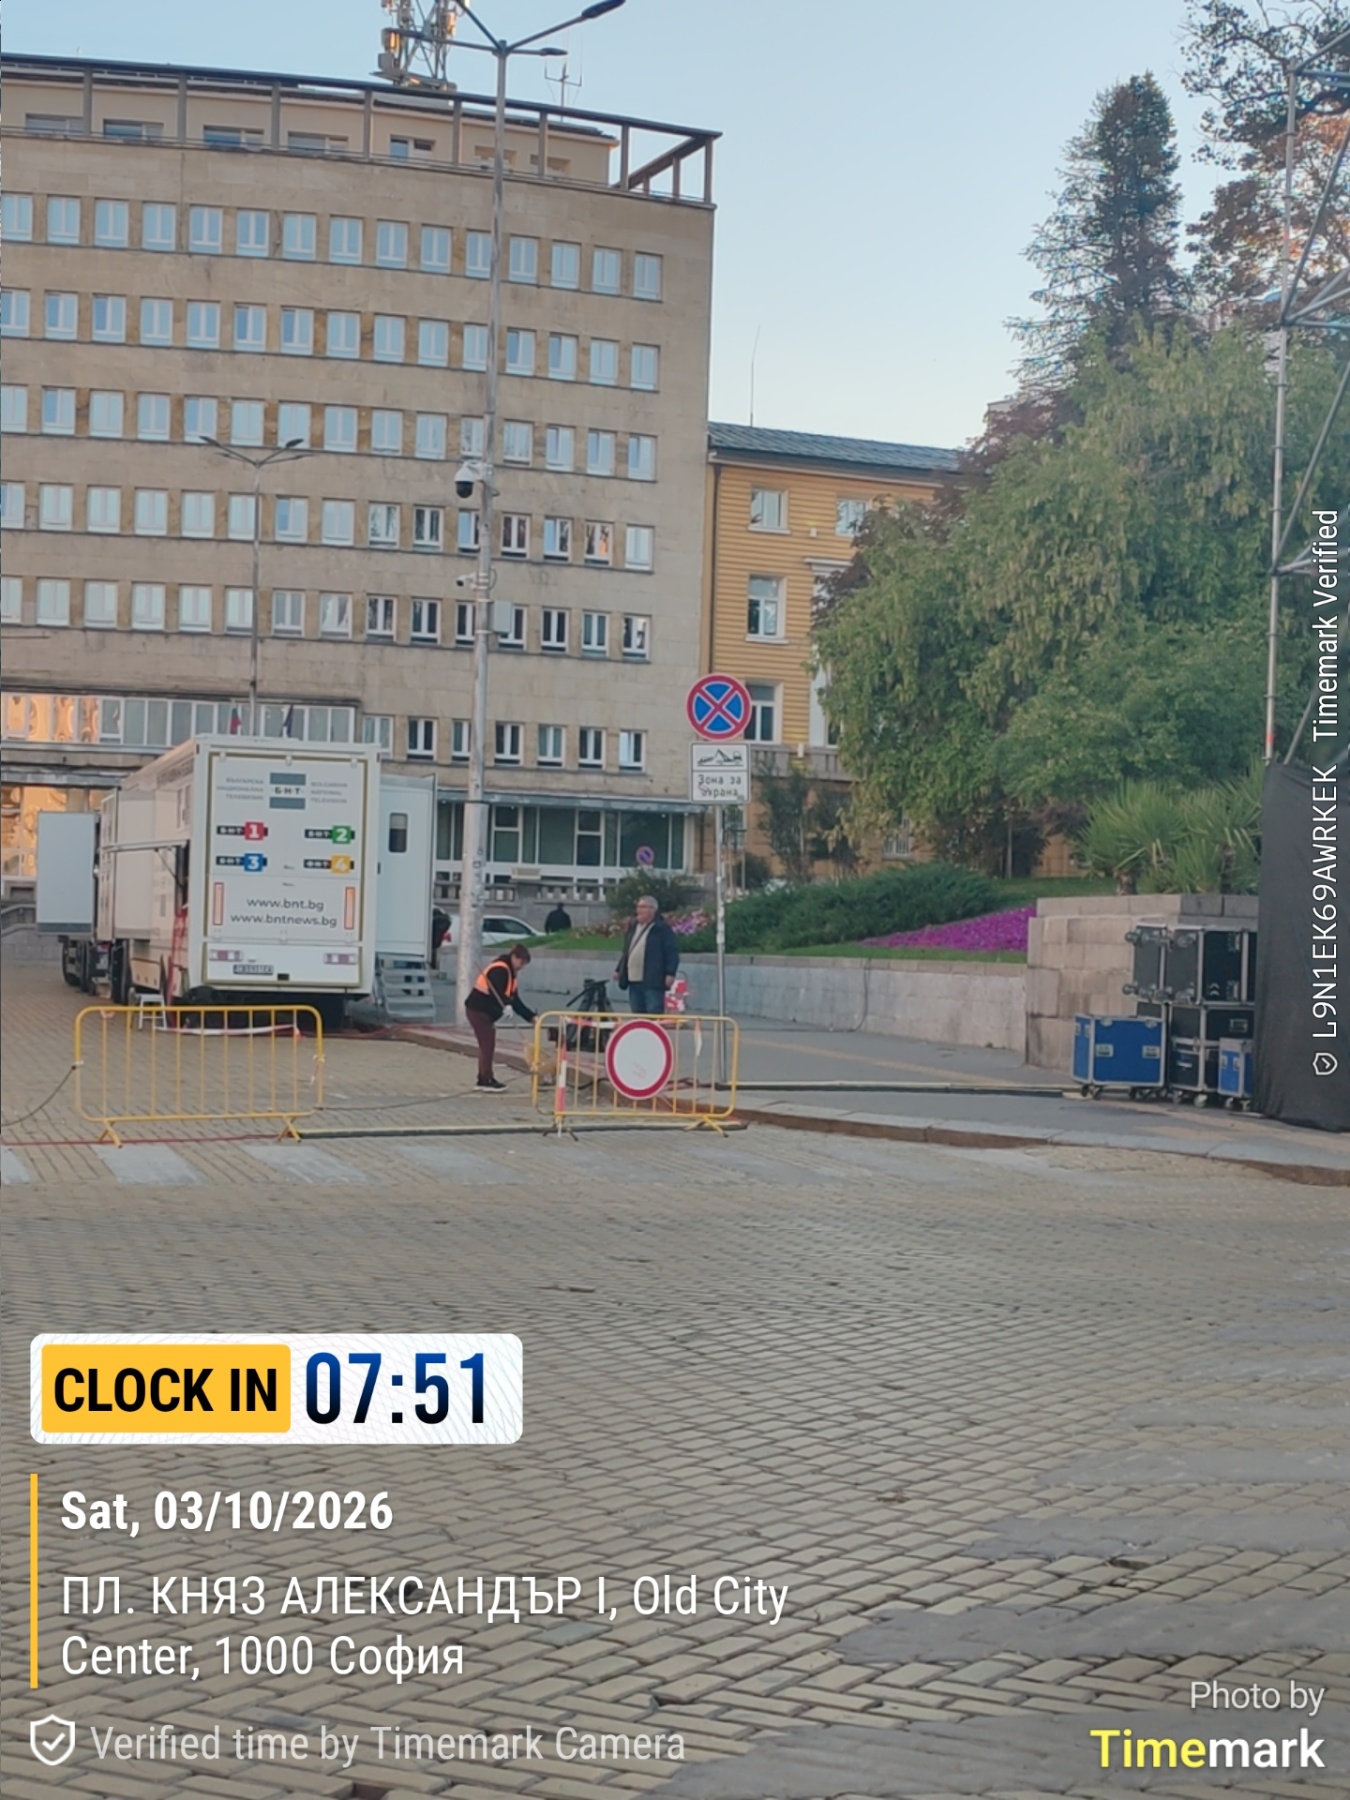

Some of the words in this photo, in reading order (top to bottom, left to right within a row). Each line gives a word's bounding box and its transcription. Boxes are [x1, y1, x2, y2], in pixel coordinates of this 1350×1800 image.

[698, 774, 724, 785] Зона
[730, 776, 742, 785] за
[247, 898, 324, 912] www.bnt.bg
[230, 914, 337, 928] www.bntnews.bg
